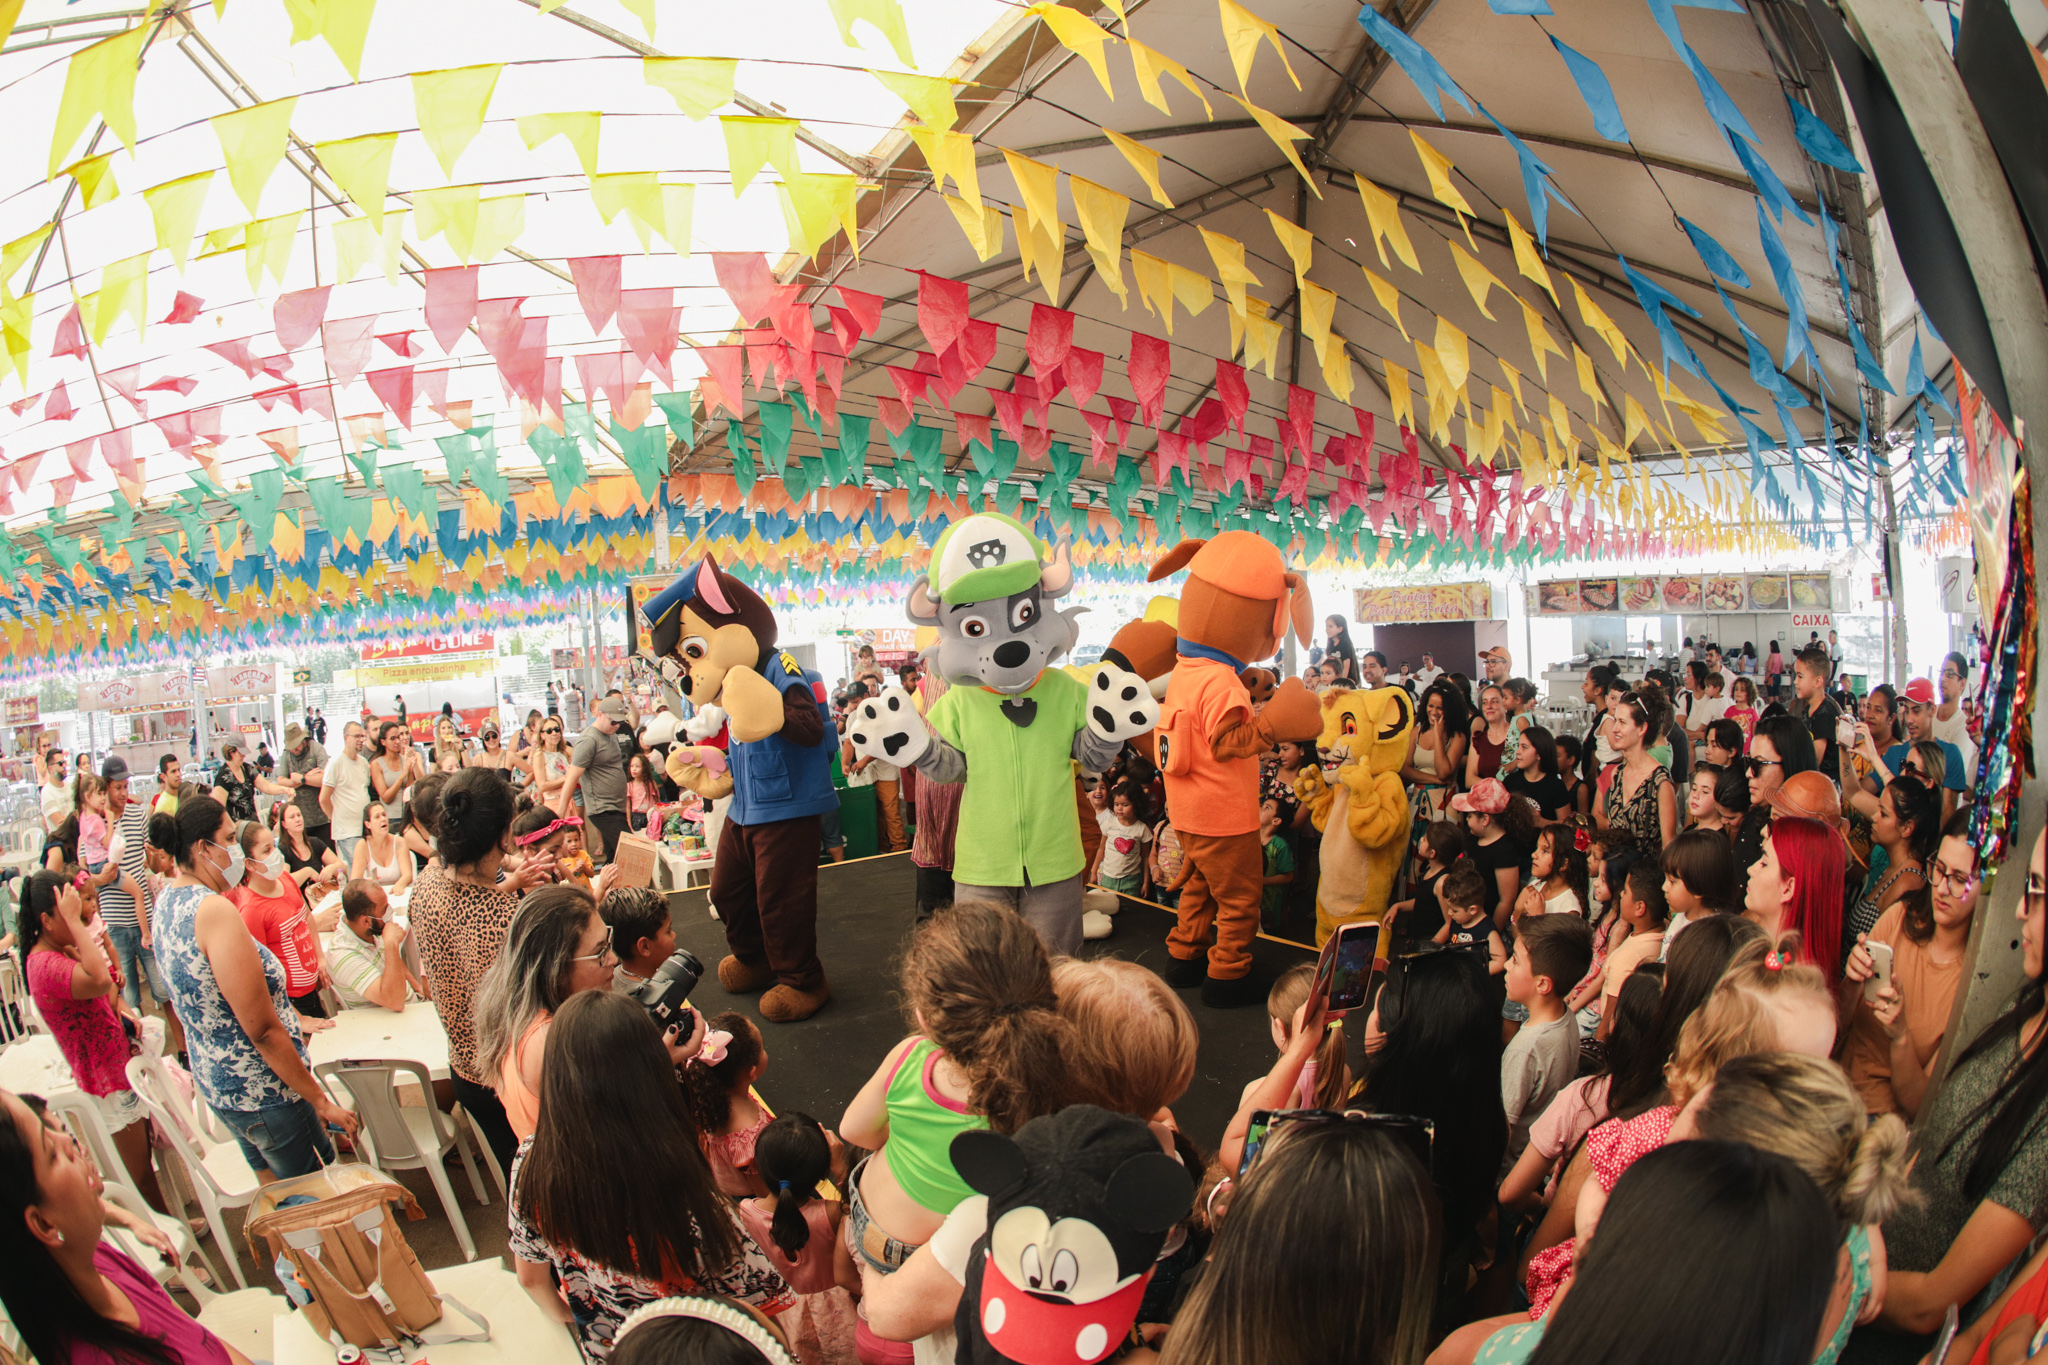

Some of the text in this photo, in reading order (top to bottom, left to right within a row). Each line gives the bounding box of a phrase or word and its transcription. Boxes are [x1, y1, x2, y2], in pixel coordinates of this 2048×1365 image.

[1366, 603, 1412, 616] Batata
[1793, 614, 1831, 626] CAIXA
[882, 630, 910, 643] DAY
[383, 664, 466, 677] Pizza enroladinha
[241, 725, 260, 733] CAIXA
